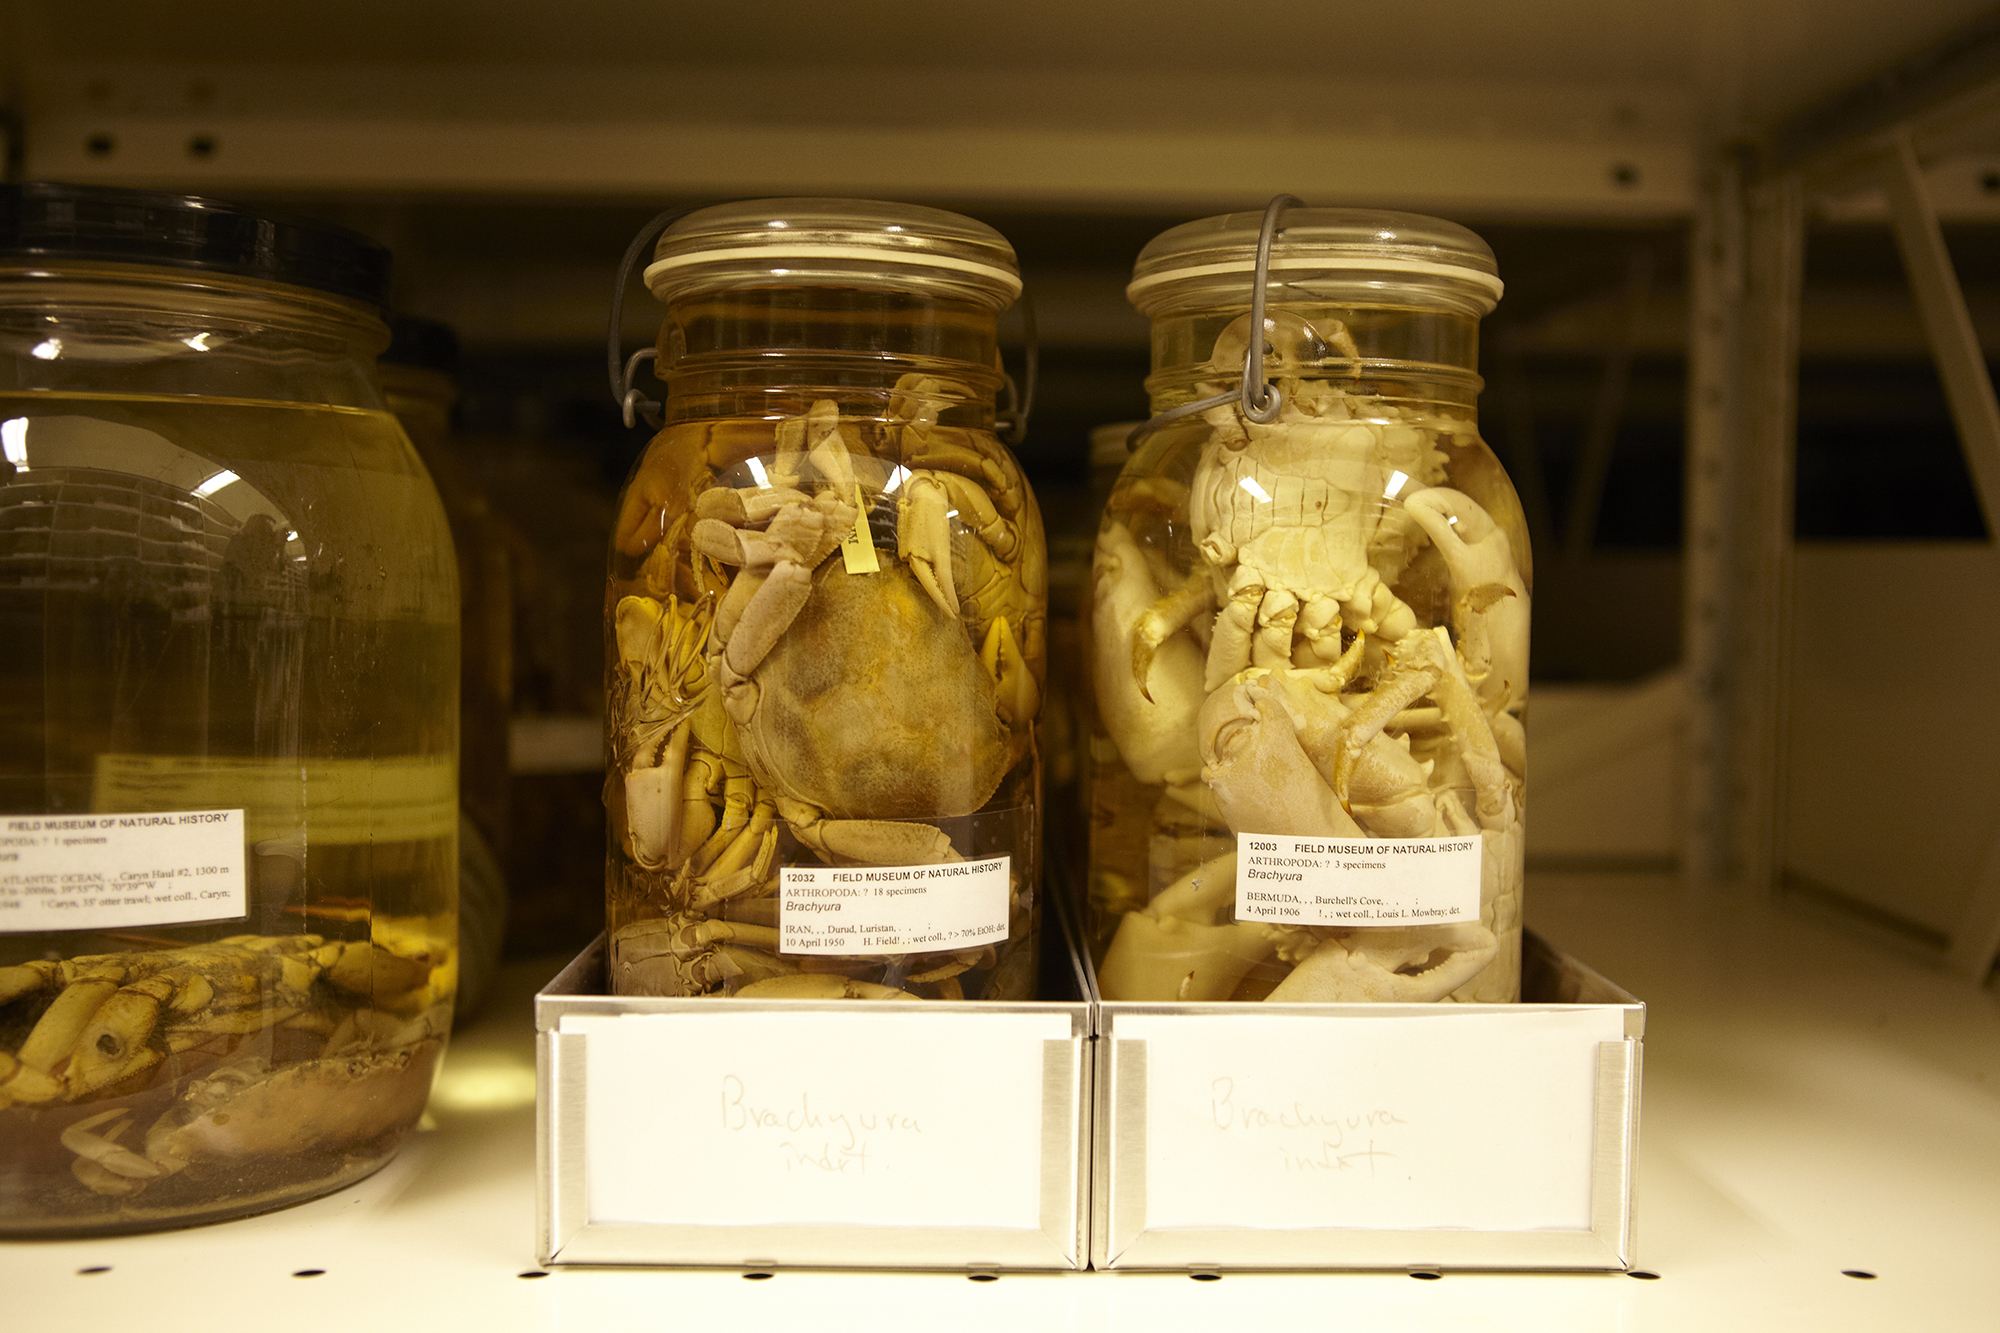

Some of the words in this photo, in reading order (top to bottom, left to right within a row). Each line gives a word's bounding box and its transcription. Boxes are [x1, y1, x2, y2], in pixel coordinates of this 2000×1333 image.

[8, 821, 41, 831] FIELD
[44, 820, 97, 830] MUSEUM
[99, 819, 115, 829] OF
[119, 817, 175, 828] NATURAL
[179, 813, 229, 824] HISTORY
[1249, 842, 1278, 851] 12003
[1294, 844, 1325, 853] FIELD
[1327, 845, 1374, 854] MUSEUM
[1376, 845, 1390, 854] OF
[1392, 845, 1437, 854] NATURAL
[1438, 842, 1474, 853] HISTORY
[1248, 856, 1323, 868] ARTHROPODA:
[1335, 860, 1340, 869] 3
[1342, 860, 1386, 870] specimens
[119, 871, 149, 881] Caryn
[152, 869, 174, 879] Haul
[195, 866, 217, 876] 1300
[786, 873, 815, 883] 12032
[833, 873, 863, 882] FIELD
[865, 871, 911, 882] MUSEUM
[913, 870, 926, 880] OF
[928, 866, 970, 878] NATURAL
[971, 862, 1003, 874] HISTORY
[1247, 868, 1303, 882] Brachyura
[154, 895, 171, 903] wet
[200, 891, 231, 900] Caryn;
[785, 888, 861, 897] ARTHROPODA:
[874, 888, 884, 896] 18
[886, 886, 928, 897] specimens
[1315, 895, 1358, 905] Burchell's
[785, 901, 842, 914] Brachyura
[1246, 905, 1252, 913] 4
[1254, 906, 1277, 916] April
[1279, 907, 1300, 916] 1906
[1335, 911, 1351, 919] wet
[1376, 909, 1400, 918] Louis
[786, 938, 797, 947] 10
[798, 938, 821, 949] April
[824, 938, 845, 947] 1950
[863, 937, 873, 946] H.
[721, 1074, 922, 1150] Brachyura
[1211, 1076, 1409, 1149] Brachyura
